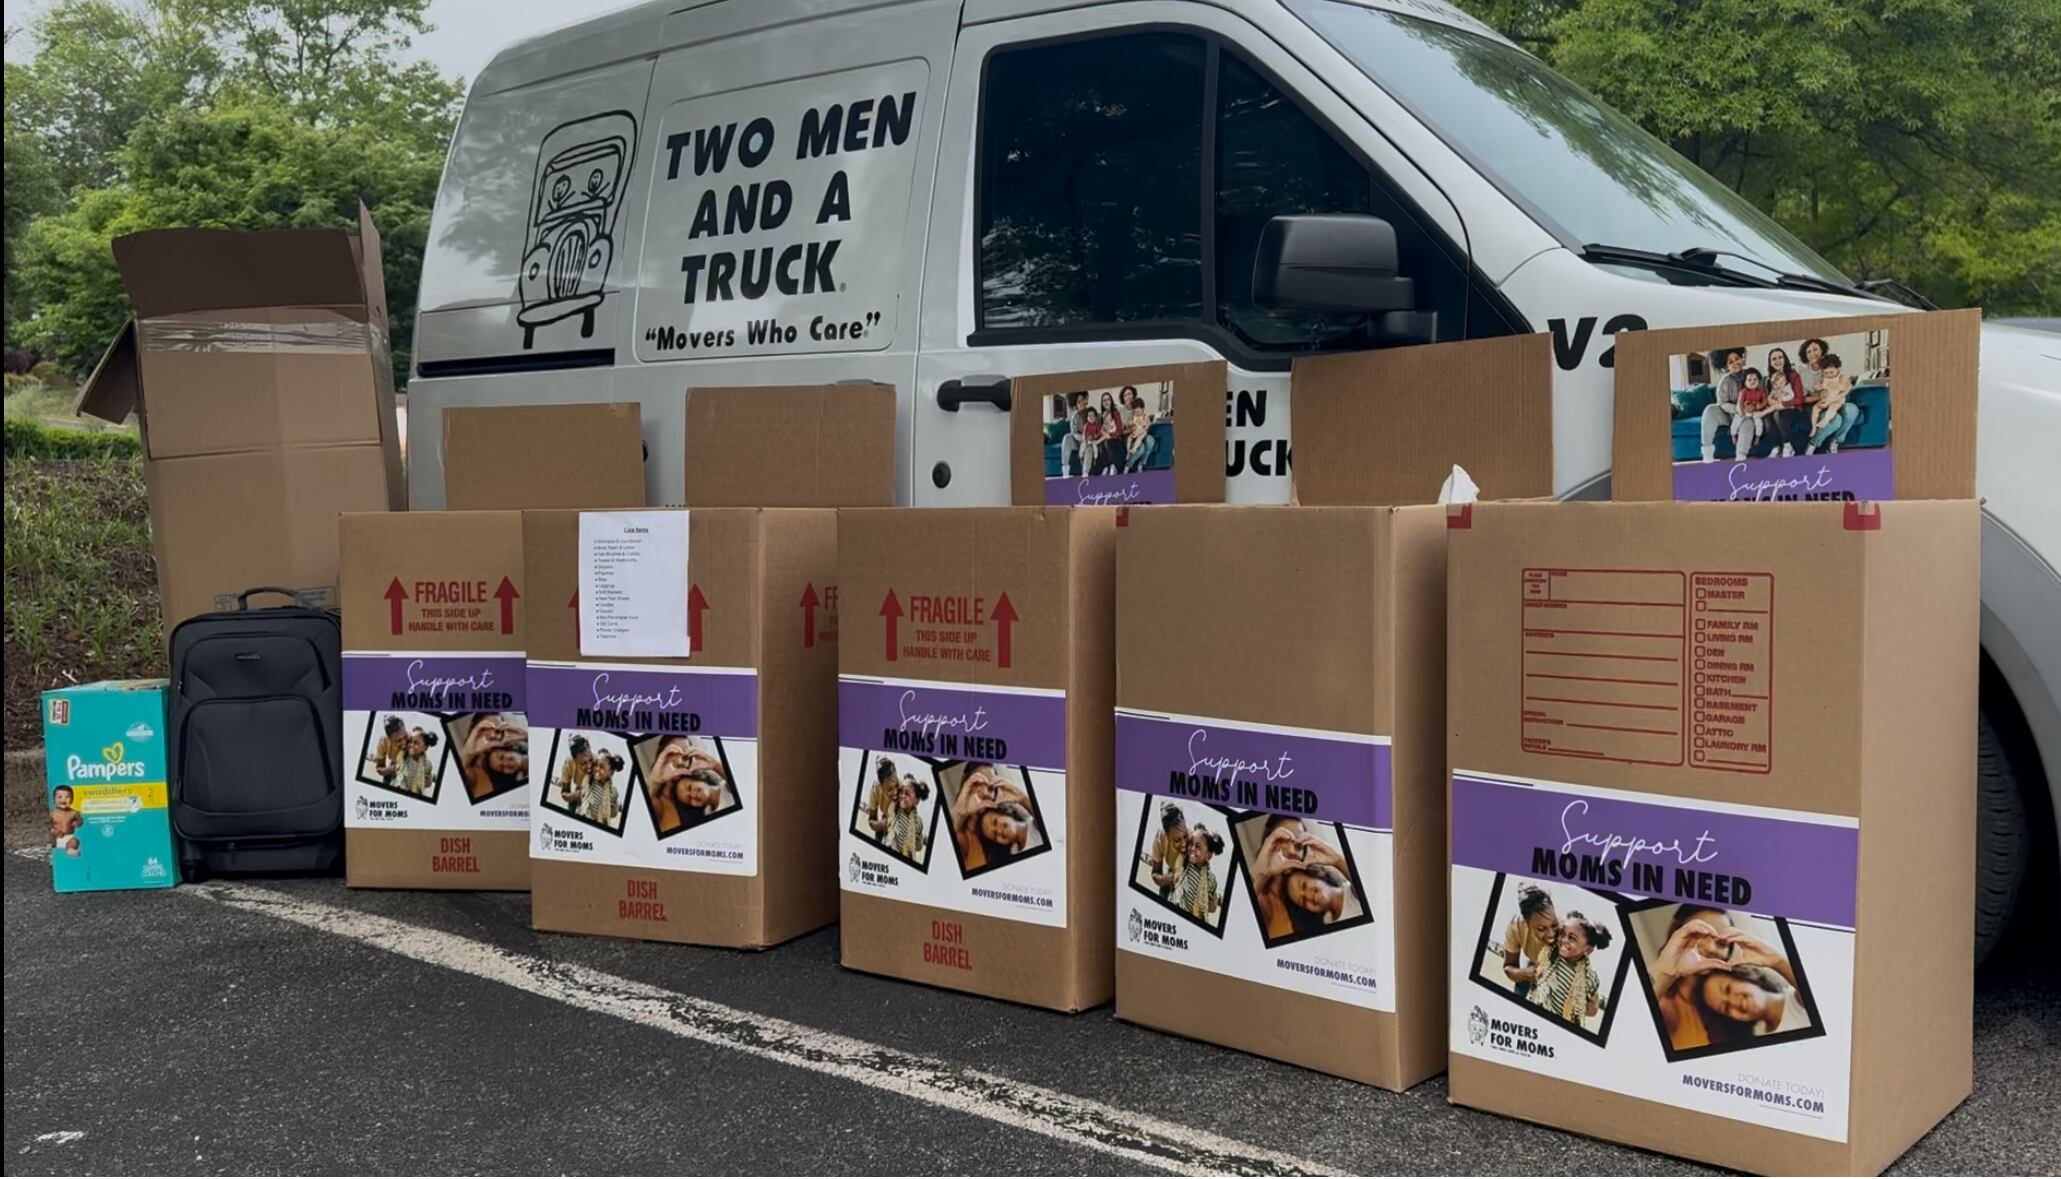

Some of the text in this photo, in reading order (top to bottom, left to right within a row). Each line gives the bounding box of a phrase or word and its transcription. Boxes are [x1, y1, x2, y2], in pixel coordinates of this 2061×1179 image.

[666, 92, 917, 181] TWO MEN
[689, 170, 851, 240] AND A
[747, 319, 797, 345] Who
[1728, 463, 1833, 502] Support
[1078, 479, 1140, 505] Support
[1695, 577, 1748, 587] BEDROOMS
[415, 581, 488, 603] FRAGILE
[1707, 590, 1745, 599] MASTER
[421, 608, 481, 618] THIS SIDE UP
[910, 596, 984, 625] FRAGILE
[408, 621, 494, 632] HANDLE WITH CARE
[1707, 620, 1758, 630] FAMILY RM
[915, 630, 978, 644] THIS SIDE UP
[1707, 633, 1753, 643] LIVING RM
[903, 646, 992, 662] HANDLE WITH CARE
[1707, 648, 1724, 657] DEN
[1707, 661, 1754, 672] DINING RM
[407, 659, 494, 698] Support
[1707, 674, 1746, 684] KITCHEN
[391, 692, 513, 709] MOMS IN NEED
[592, 672, 684, 713] Support
[1706, 687, 1731, 696] BATH
[899, 690, 989, 738] Support
[1706, 701, 1758, 712] BASEMENT
[576, 708, 701, 732] MOMS IN NEED
[1706, 714, 1745, 724] GARAGE
[1705, 728, 1733, 737] ATTIC
[884, 728, 1007, 760] MOMS IN NEED
[1705, 741, 1767, 753] LAUNDRY RM
[1188, 729, 1294, 786] Support
[67, 754, 145, 781] Pampers
[1169, 771, 1318, 814] MOMS IN NEED
[369, 801, 398, 809] MOVERS
[369, 810, 408, 818] FOR MOMS
[554, 830, 584, 840] MOVERS
[1561, 799, 1718, 869] Support
[440, 837, 471, 854] DISH
[554, 839, 594, 851] FOR MOMS
[666, 846, 744, 860] MOVERSFORMOMS.COM
[432, 856, 480, 873] BARREL
[862, 860, 889, 873] MOVERS
[862, 872, 875, 883] FOR
[876, 874, 899, 886] MOMS
[1532, 847, 1752, 906] MOMS IN NEED
[627, 879, 658, 900] DISH
[971, 888, 1053, 908] MOVERSFORMOMS.COM
[618, 900, 668, 922] BARREL
[932, 921, 963, 945] DISH
[1144, 918, 1177, 935] MOVERS
[1144, 931, 1160, 943] FOR
[1162, 935, 1189, 950] MOMS
[923, 942, 972, 971] BARREL
[1277, 958, 1377, 988] MOVERSFORMOMS.COM
[1490, 1018, 1538, 1040] MOVERS
[1490, 1032, 1512, 1048] FOR
[1516, 1038, 1554, 1058] MOMS
[1737, 1072, 1782, 1090] DONATE
[1682, 1074, 1824, 1113] MOVERSFORMOMS.COM
